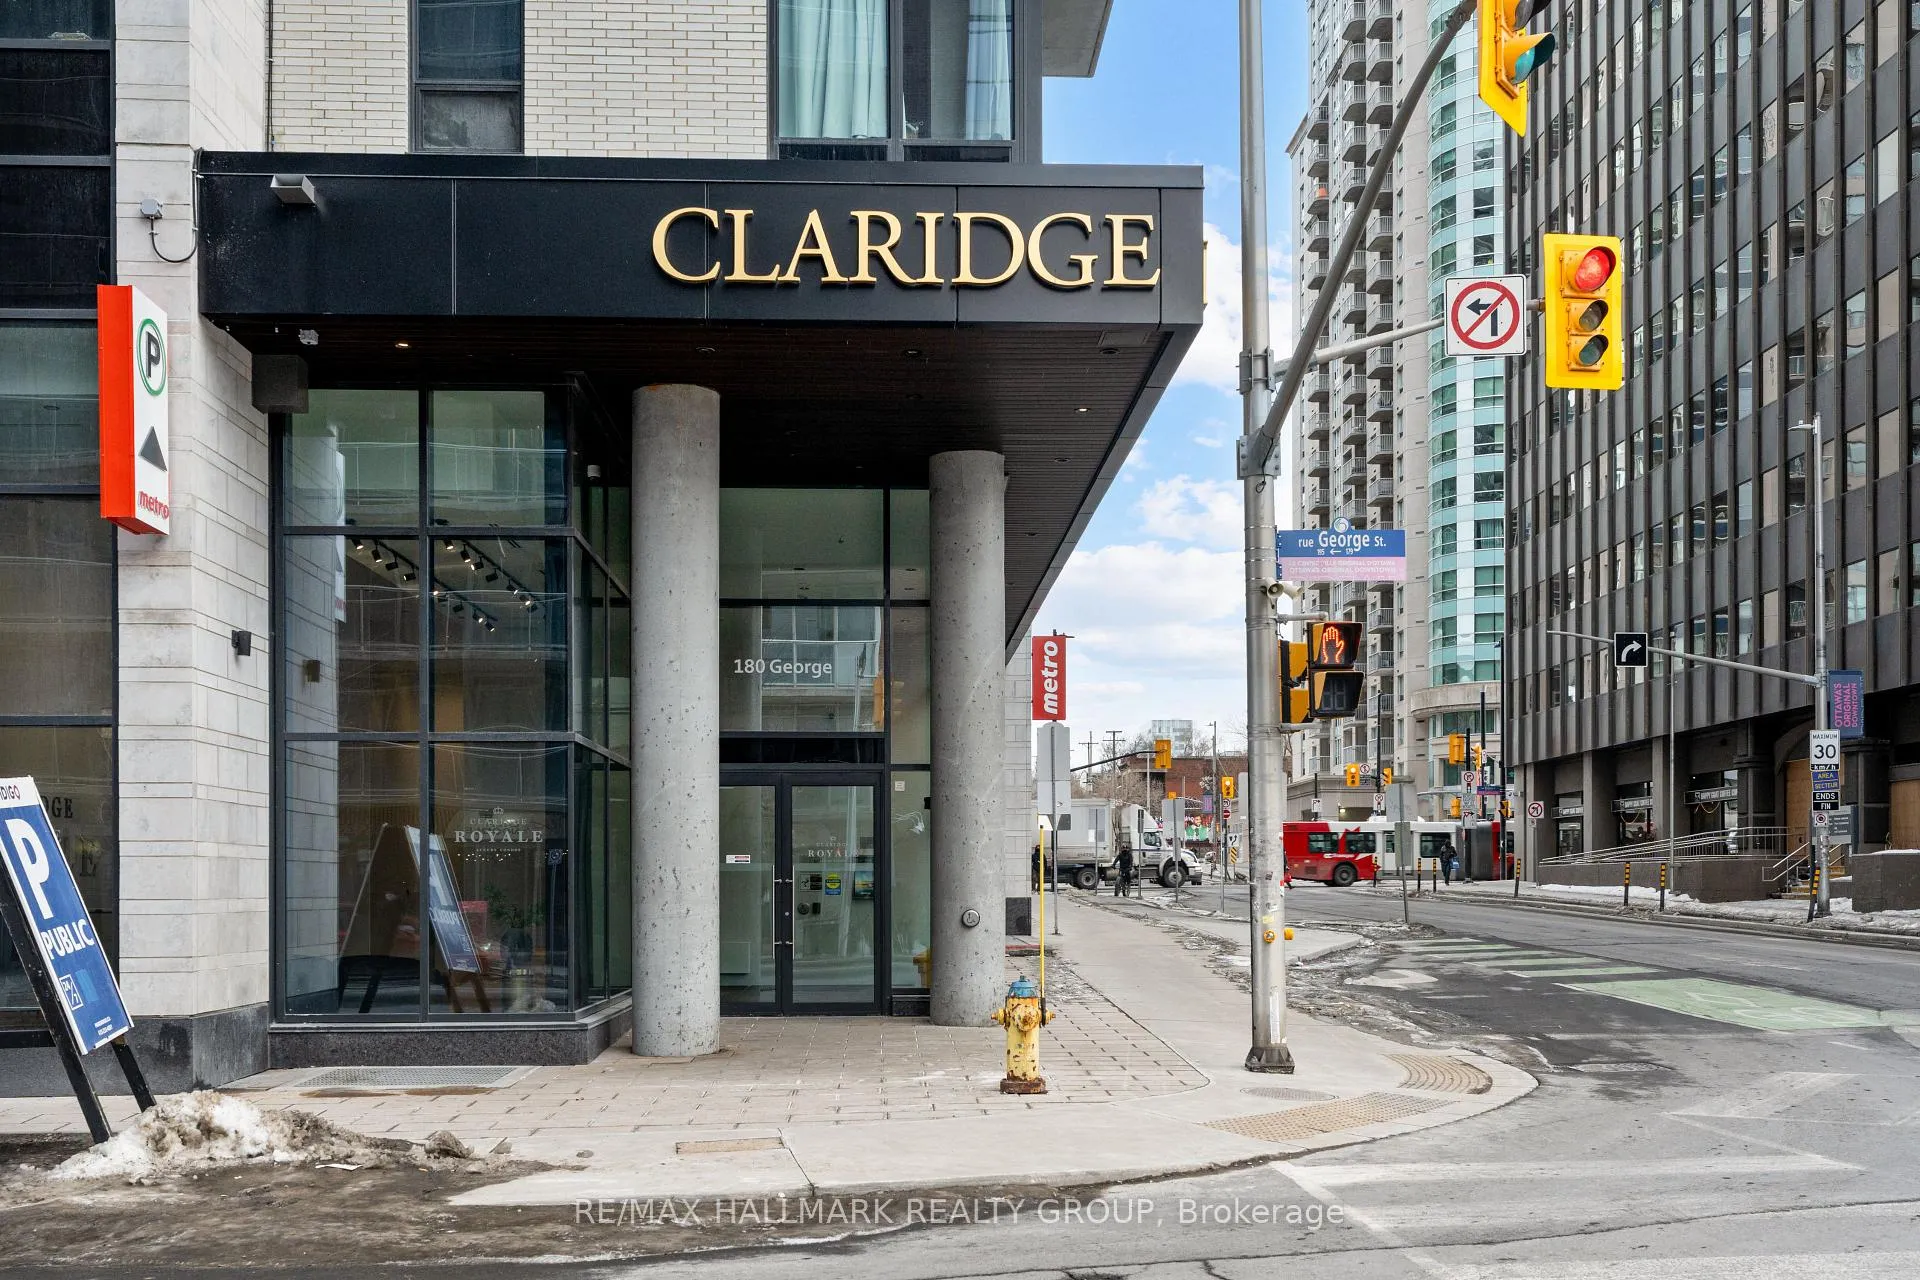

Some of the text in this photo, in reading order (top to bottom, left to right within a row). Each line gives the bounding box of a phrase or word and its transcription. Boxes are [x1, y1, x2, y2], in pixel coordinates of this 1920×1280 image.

[651, 207, 1161, 289] CLARIDGE
[145, 330, 161, 379] P
[139, 490, 170, 519] metro
[1298, 530, 1387, 552] rue George St.
[733, 658, 833, 678] 180 George
[1041, 640, 1059, 715] metro
[1843, 682, 1851, 728] ORIGINAL
[1813, 744, 1837, 760] 30
[1814, 781, 1839, 790] SECTEUR
[1817, 772, 1835, 780] AREA
[0, 785, 20, 801] DIGO
[1815, 792, 1836, 800] ENDS
[1820, 802, 1831, 810] FIN
[454, 830, 543, 843] ROYALE
[4, 818, 54, 920] P
[41, 918, 95, 960] PUBLIC
